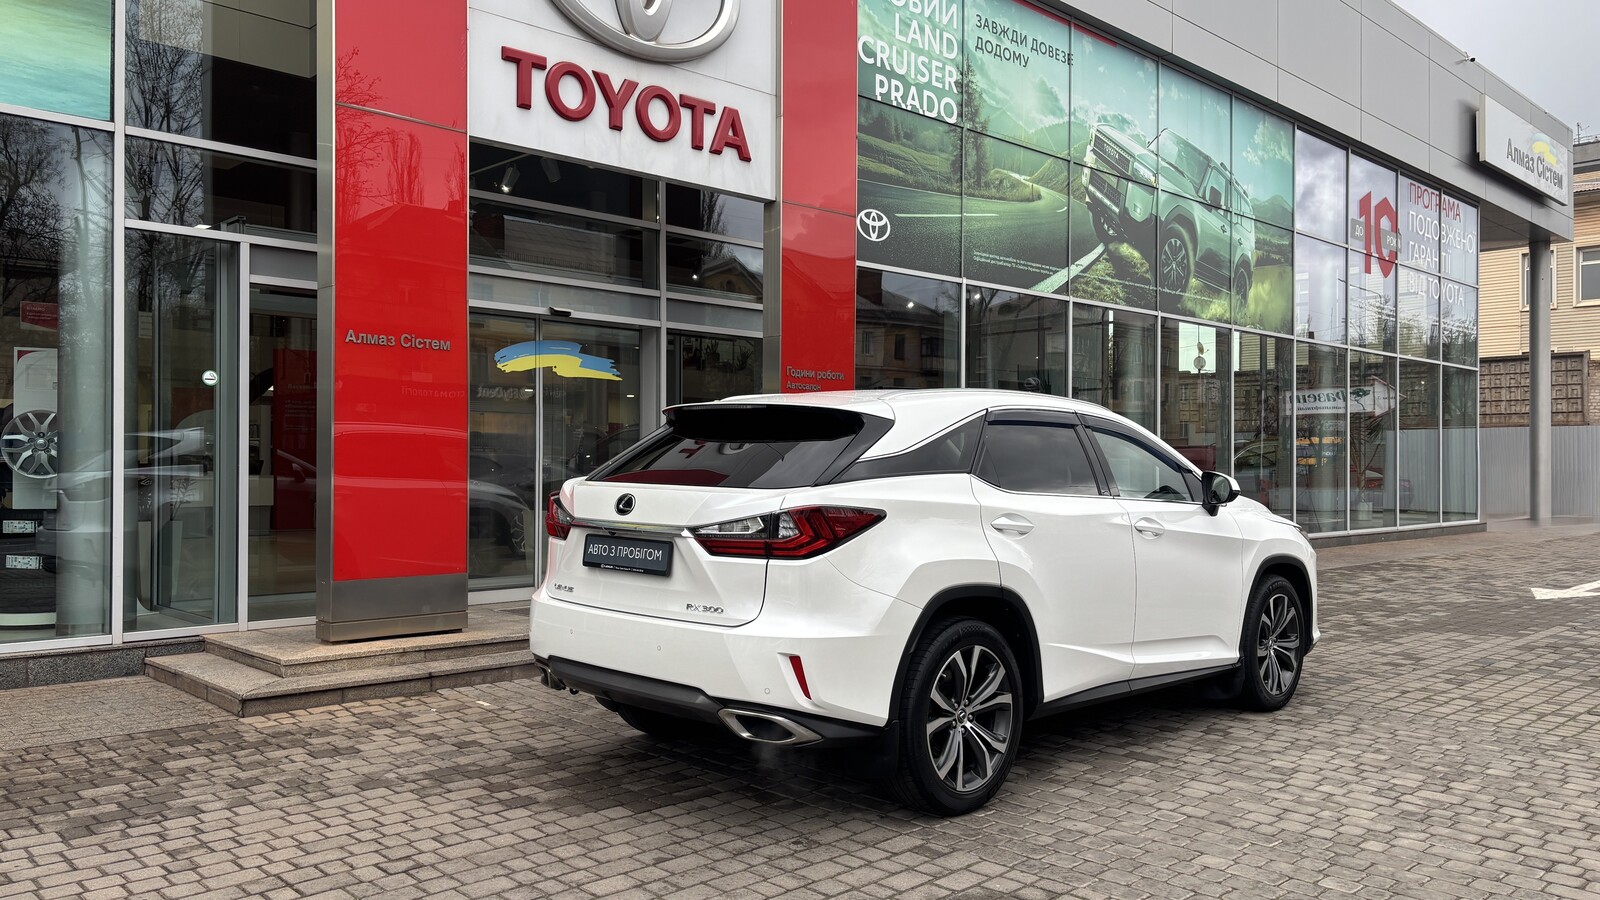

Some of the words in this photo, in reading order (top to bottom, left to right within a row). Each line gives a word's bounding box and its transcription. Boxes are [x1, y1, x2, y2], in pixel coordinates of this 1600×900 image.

[895, 13, 958, 60] LAND
[975, 14, 1028, 47] ЗАВЖДИ
[1030, 38, 1074, 66] ДОВЕЗЕ
[975, 36, 1029, 68] ДОДОМУ
[858, 35, 958, 94] CRUISER
[501, 46, 752, 162] TOYOTA
[875, 74, 958, 124] PRADO
[1506, 138, 1535, 174] Алмаз
[1537, 155, 1563, 190] Сістем
[1409, 182, 1462, 222] ПРОГРАМА
[1355, 225, 1364, 237] ДО
[1409, 211, 1477, 254] ПОДОВЖЕНОЇ
[1428, 278, 1464, 306] TOYOTA
[345, 330, 396, 346] Алмаз
[400, 333, 451, 351] Сістем
[786, 366, 815, 379] Години
[816, 370, 844, 381] роботи
[786, 381, 821, 391] Автосалон
[588, 544, 609, 556] АВТО
[617, 547, 662, 561] ПРОБІГОМ
